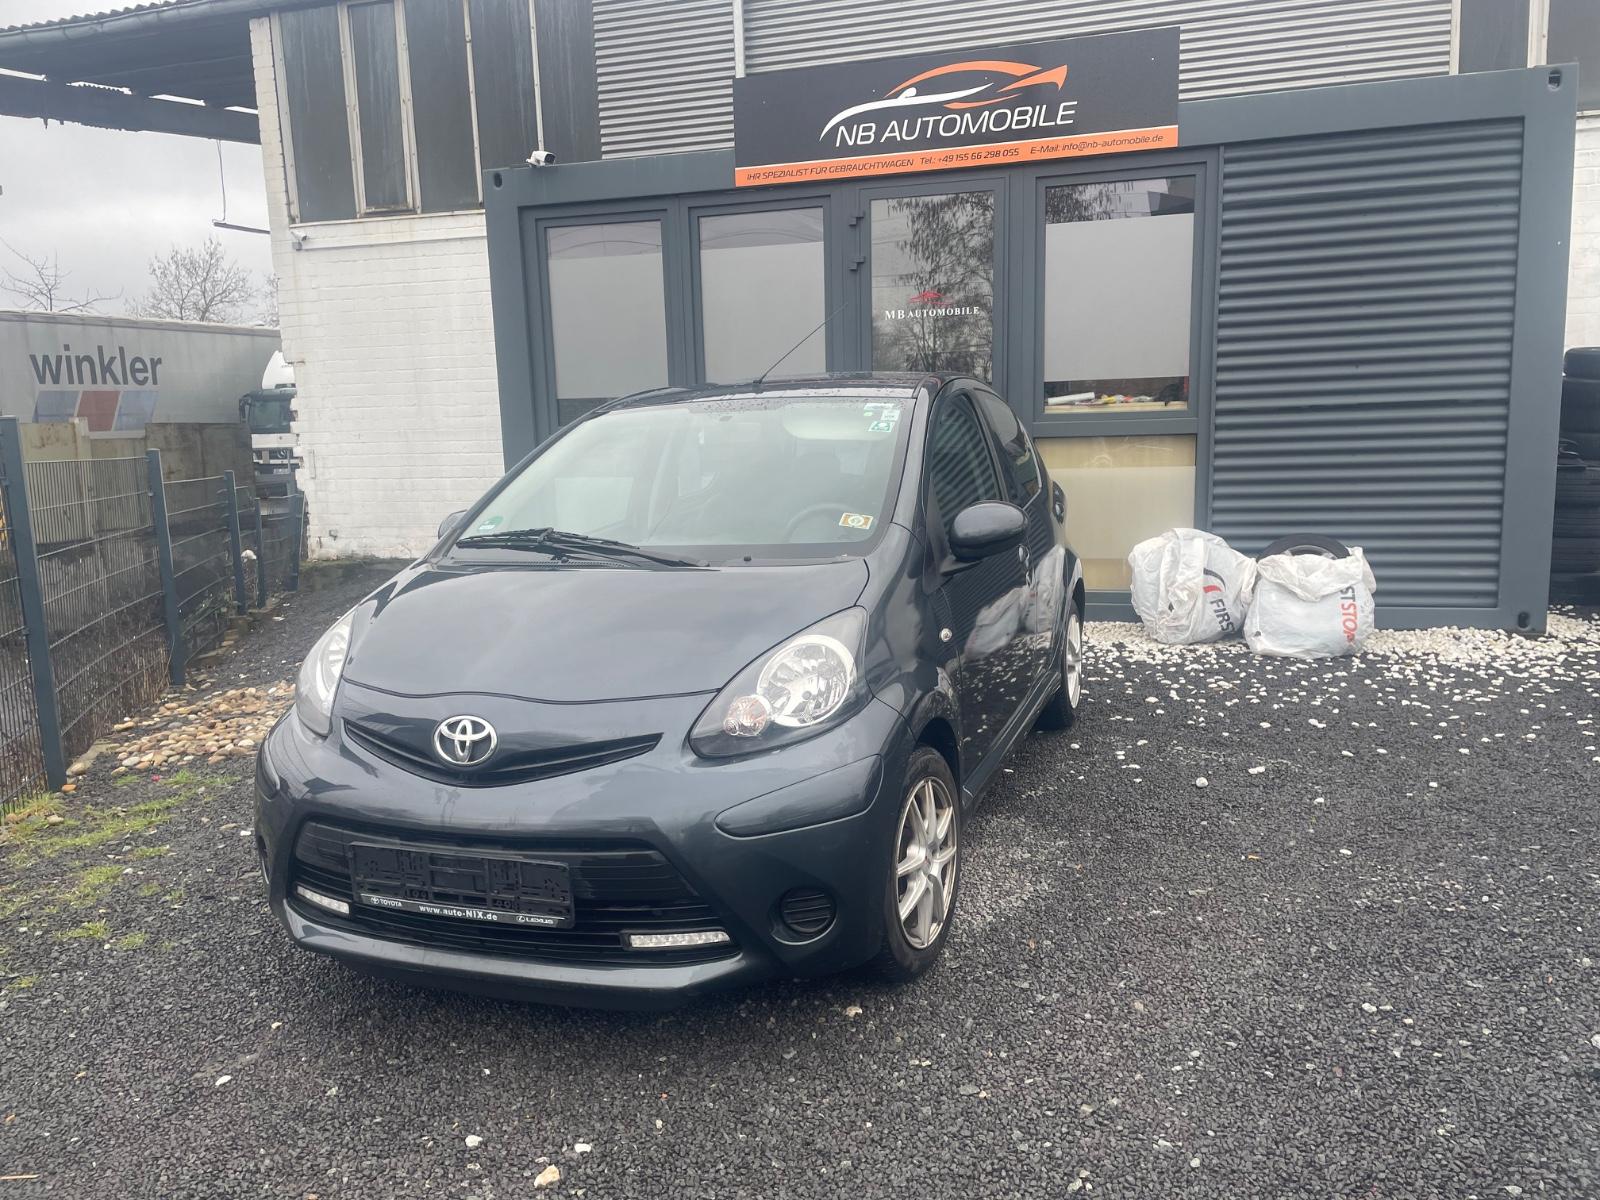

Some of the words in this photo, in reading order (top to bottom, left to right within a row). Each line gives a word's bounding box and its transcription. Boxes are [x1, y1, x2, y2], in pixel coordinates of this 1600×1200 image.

[836, 123, 875, 147] NB
[880, 101, 1078, 143] AUTOMOBILE
[747, 172, 761, 181] IHR
[762, 168, 809, 180] SPEZIALIST
[810, 166, 828, 176] FÜR
[828, 158, 914, 174] GEBRAUCHTWAGEN
[920, 157, 936, 165] Tel.:
[938, 155, 953, 163] +49
[955, 153, 969, 161] 155
[971, 152, 982, 160] 66
[983, 150, 1001, 159] 298
[1002, 148, 1019, 156] 055
[1030, 144, 1060, 155] E-Mail:
[1061, 134, 1163, 152] info@nb-automobile.de
[907, 306, 980, 319] AUTOMOBILE
[29, 344, 162, 386] winkler
[1210, 598, 1236, 632] FIRS
[379, 898, 402, 907] TOYOTA
[526, 916, 554, 925] LEXUS
